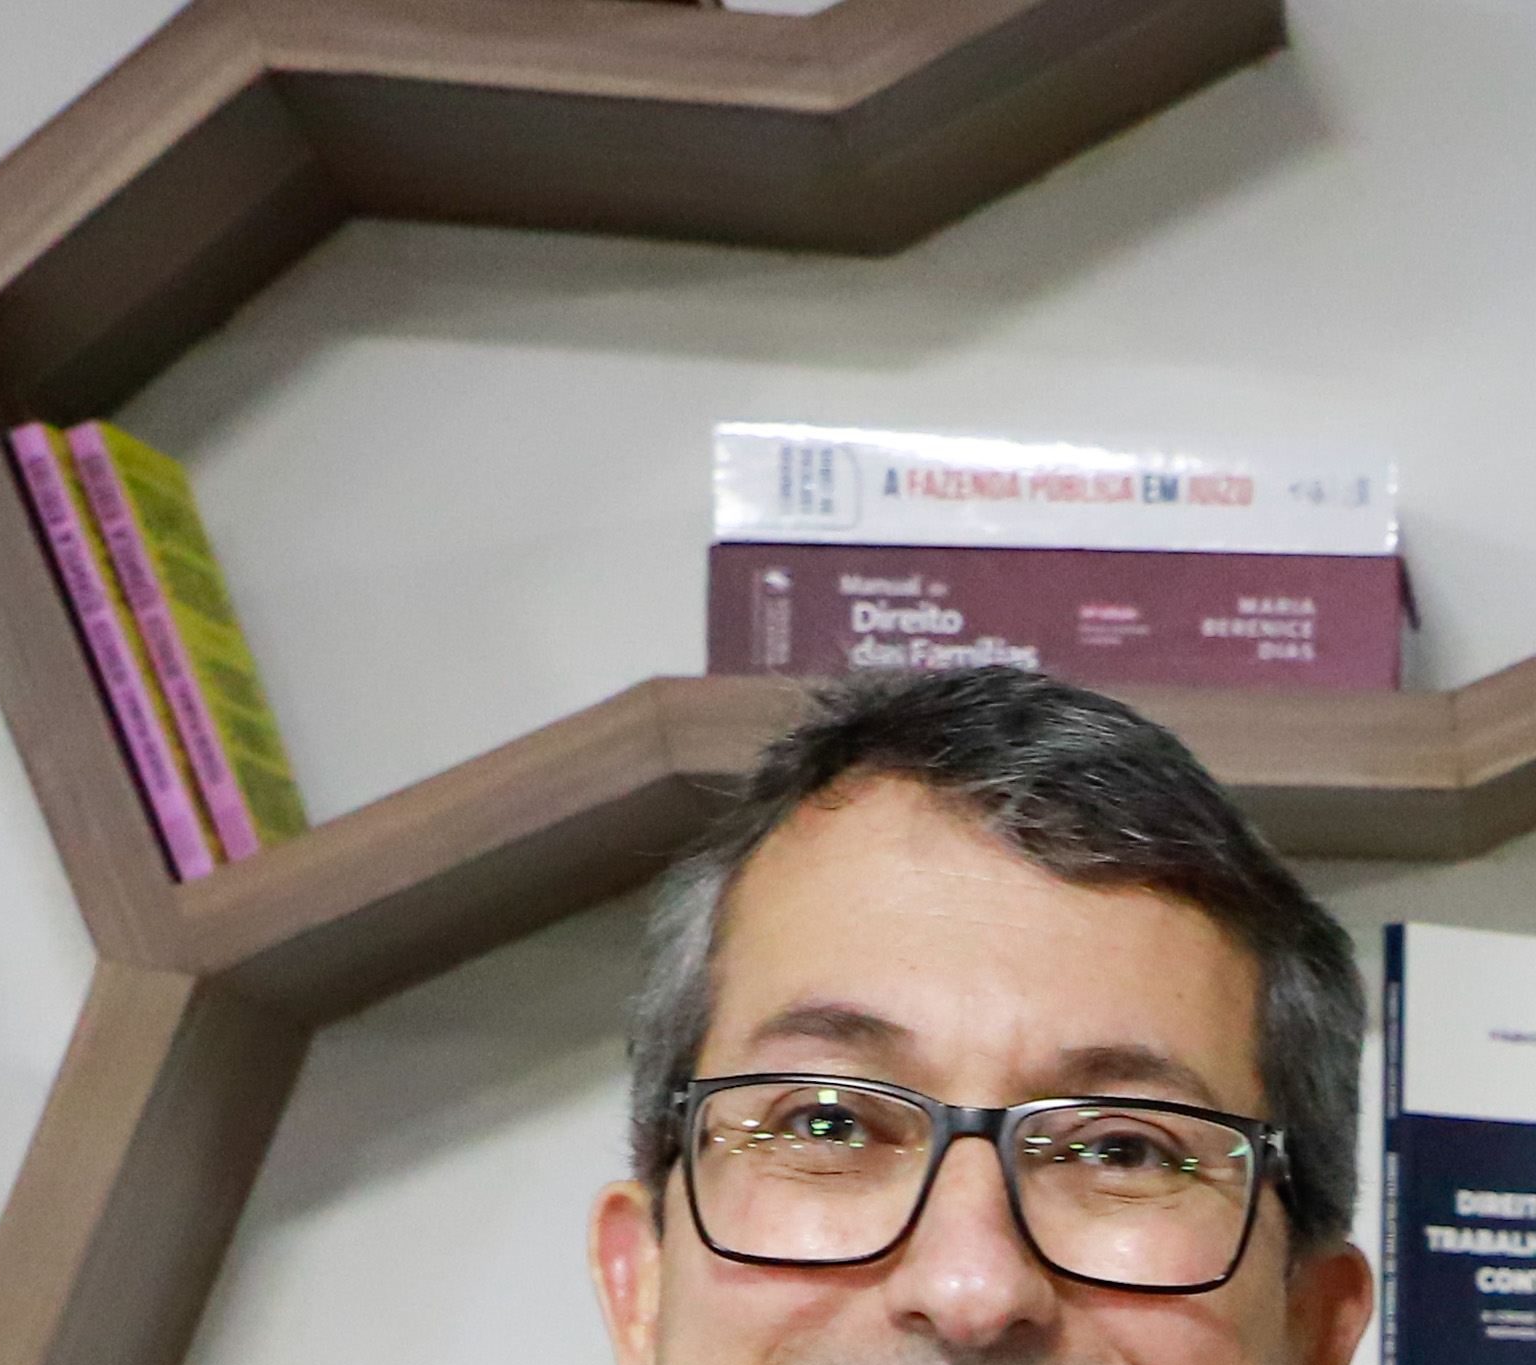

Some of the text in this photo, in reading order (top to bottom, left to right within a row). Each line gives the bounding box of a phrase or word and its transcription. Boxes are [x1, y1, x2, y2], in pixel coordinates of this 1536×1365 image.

[884, 468, 900, 497] A
[905, 469, 1021, 500] FAZENDA
[1144, 474, 1180, 503] EM
[839, 573, 922, 598] Manual
[1237, 597, 1316, 616] MARIA
[852, 602, 963, 635] Direito
[1200, 619, 1315, 641] BERENICE
[1257, 641, 1315, 662] DIAS
